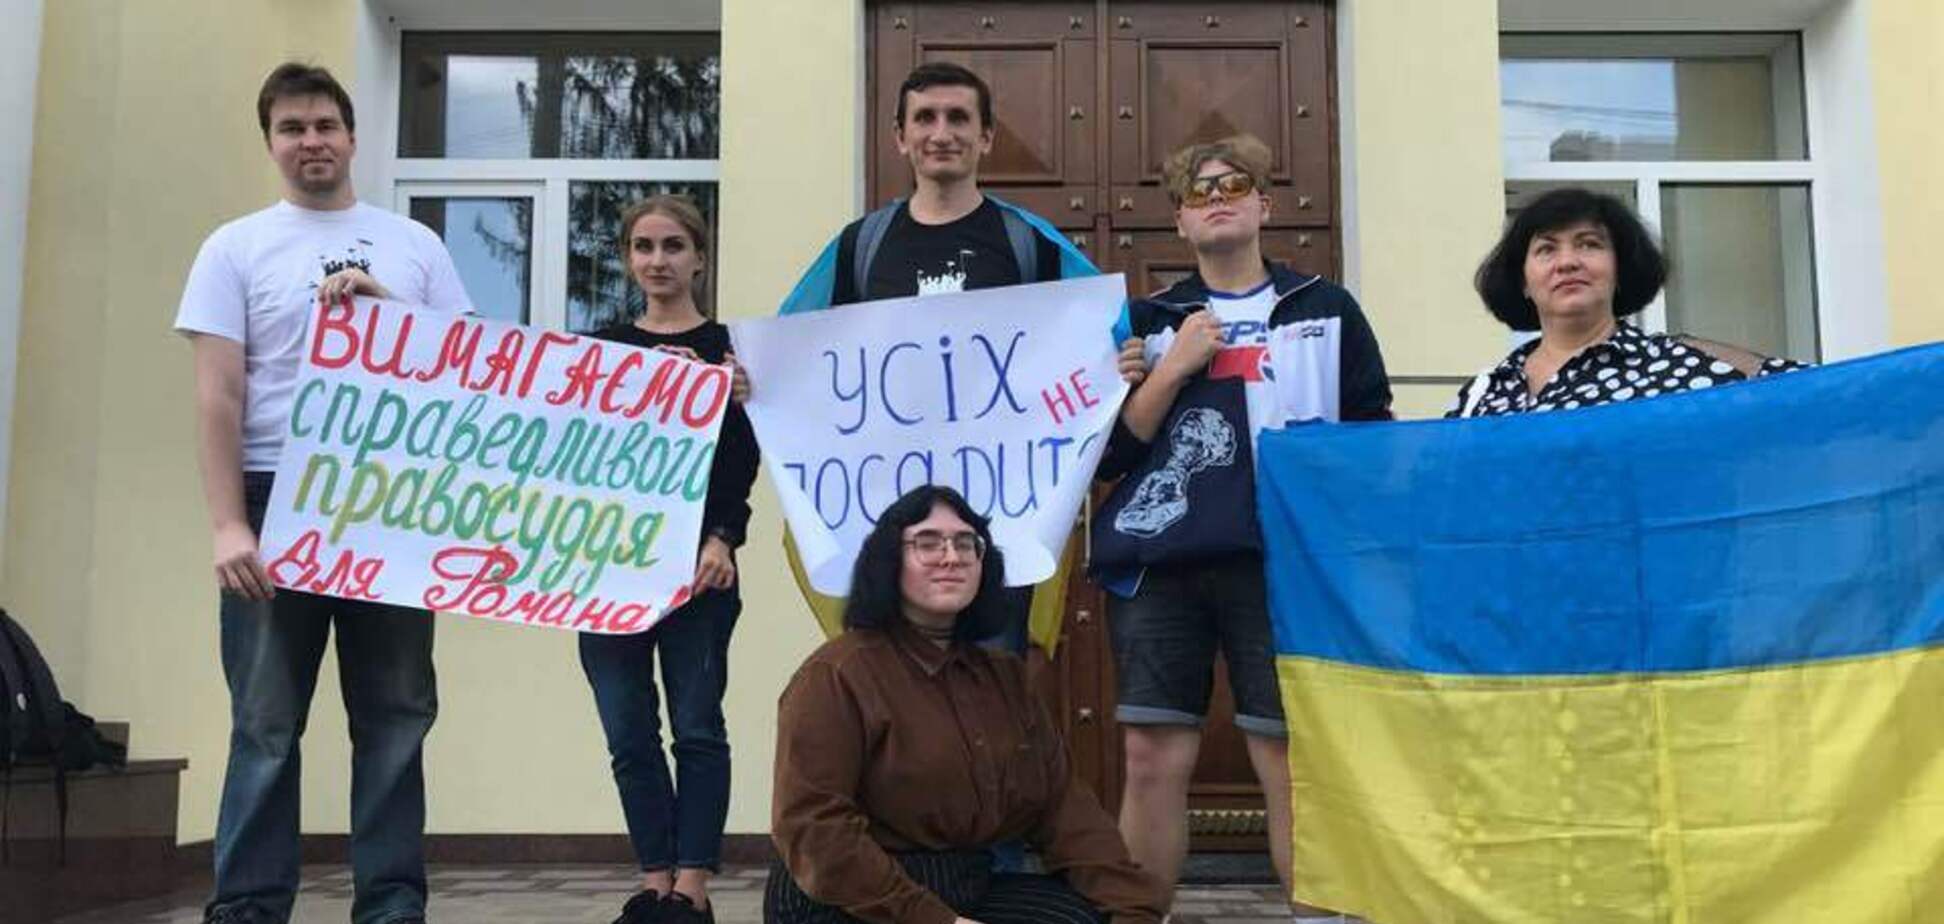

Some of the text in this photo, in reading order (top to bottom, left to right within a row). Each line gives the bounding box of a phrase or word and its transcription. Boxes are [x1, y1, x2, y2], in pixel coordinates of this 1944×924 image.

[310, 298, 729, 430] ВИМАГАЄМО
[1041, 368, 1099, 424] НЕ
[291, 378, 716, 503] справедливого
[266, 530, 385, 600] Для
[293, 452, 665, 602] правосуддя
